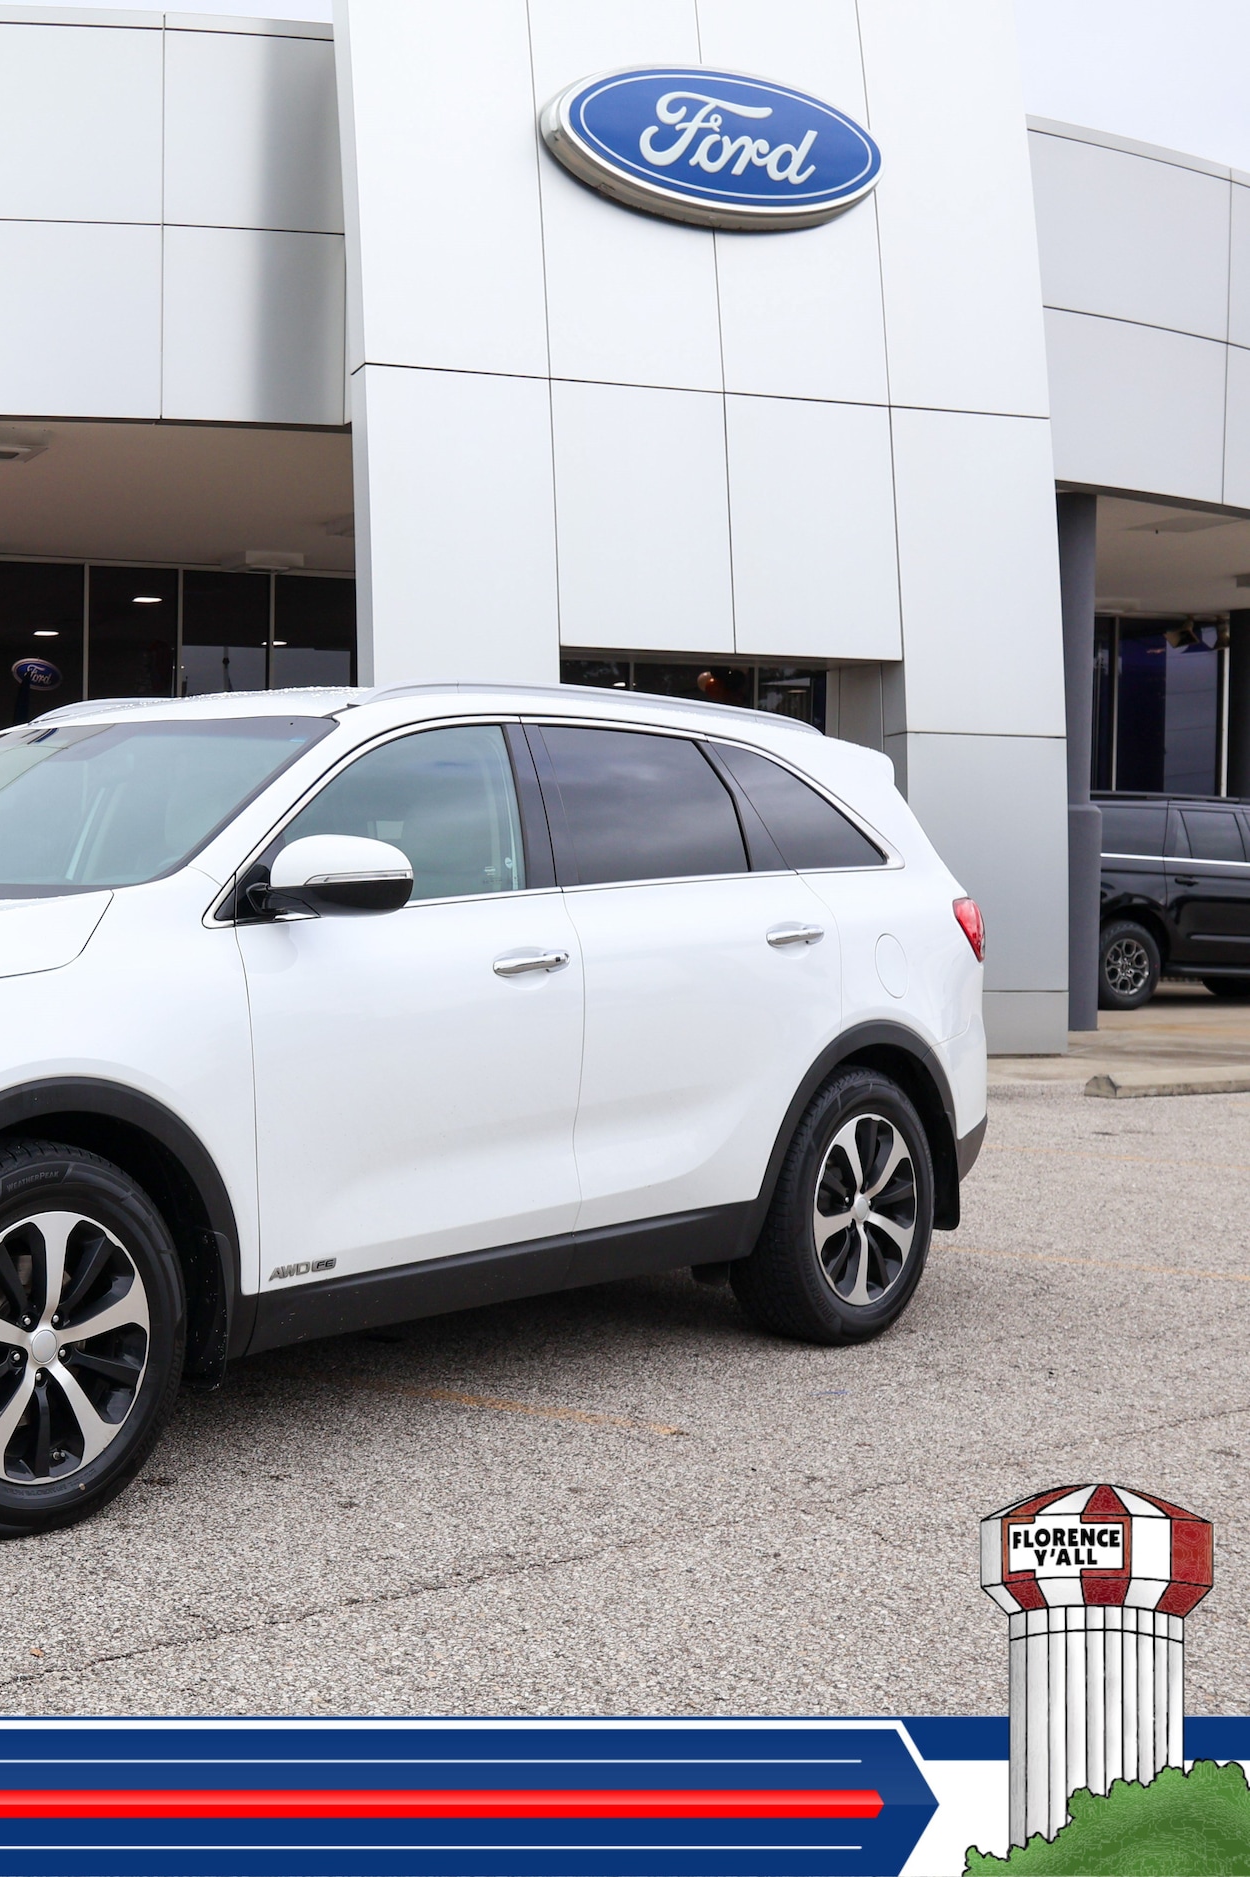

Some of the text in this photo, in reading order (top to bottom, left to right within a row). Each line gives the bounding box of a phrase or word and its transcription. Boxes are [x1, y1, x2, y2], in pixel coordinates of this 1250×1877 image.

[639, 90, 818, 185] Ford
[23, 664, 53, 685] Ford
[268, 1261, 310, 1282] AWD
